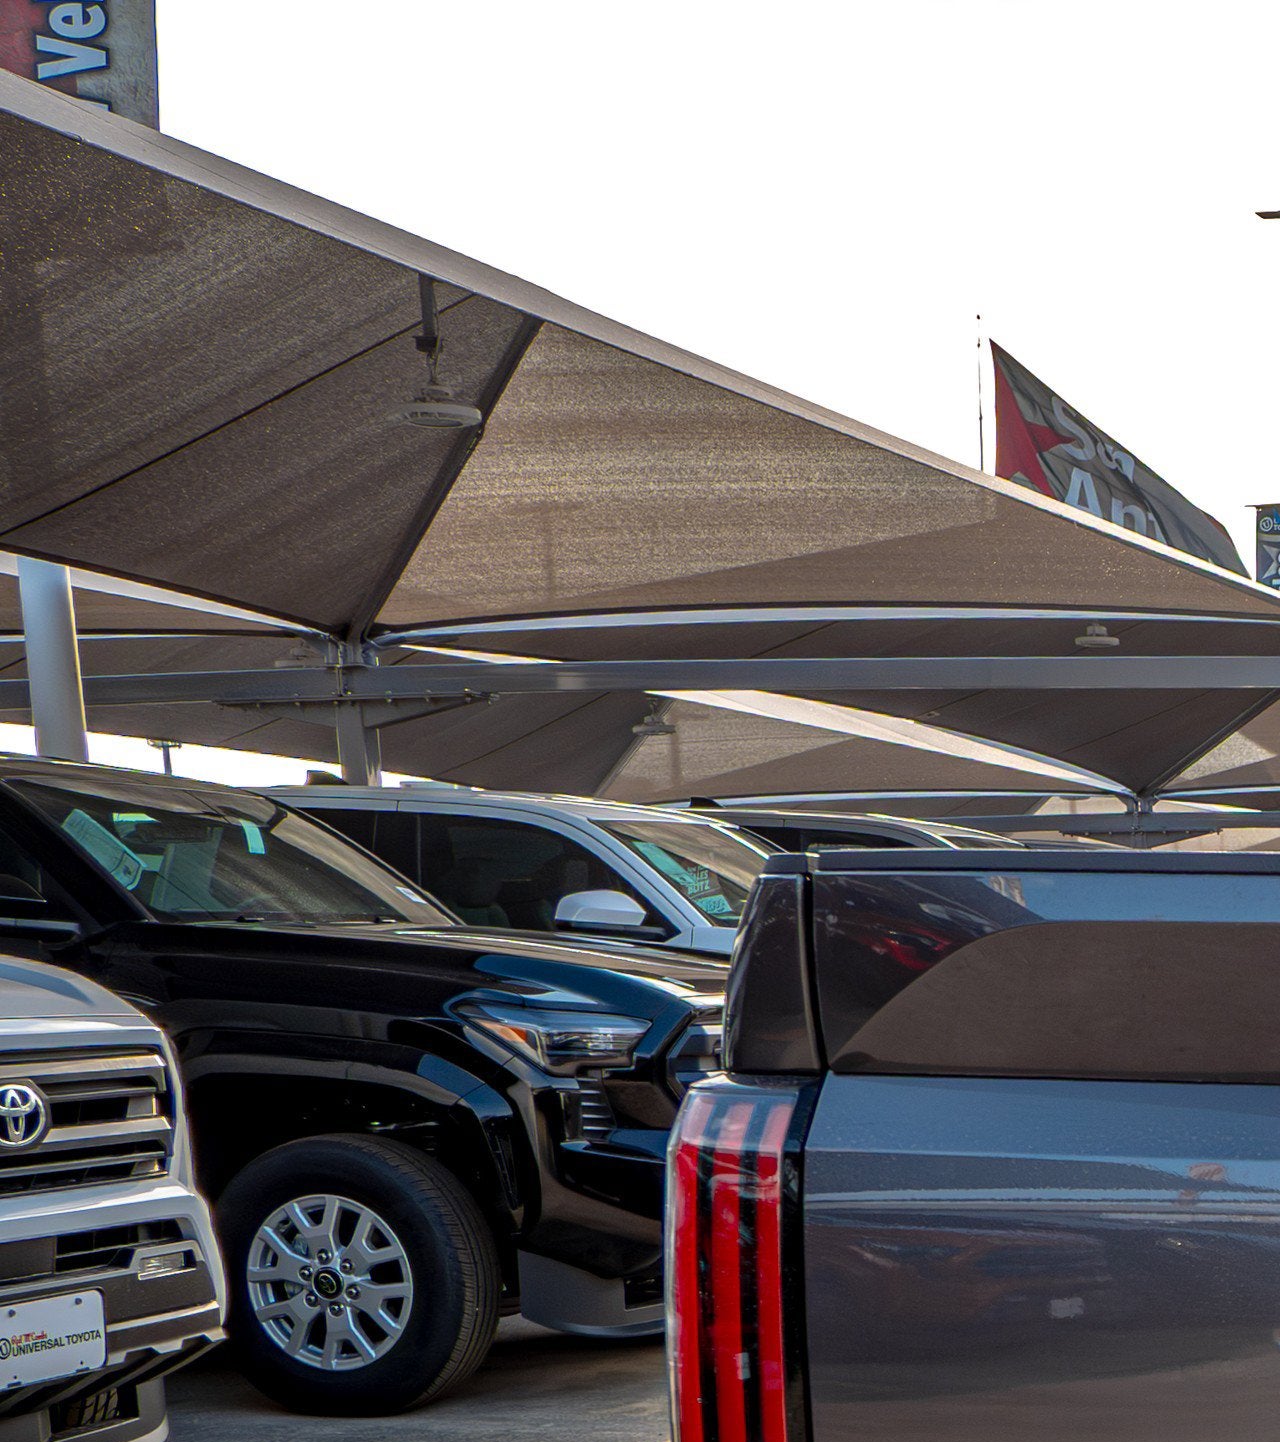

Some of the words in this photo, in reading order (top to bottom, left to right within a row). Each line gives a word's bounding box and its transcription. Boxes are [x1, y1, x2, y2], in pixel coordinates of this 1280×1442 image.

[36, 0, 108, 80] Ve
[12, 1336, 66, 1357] UNIVERSAL
[65, 1329, 102, 1346] TOYOTA
